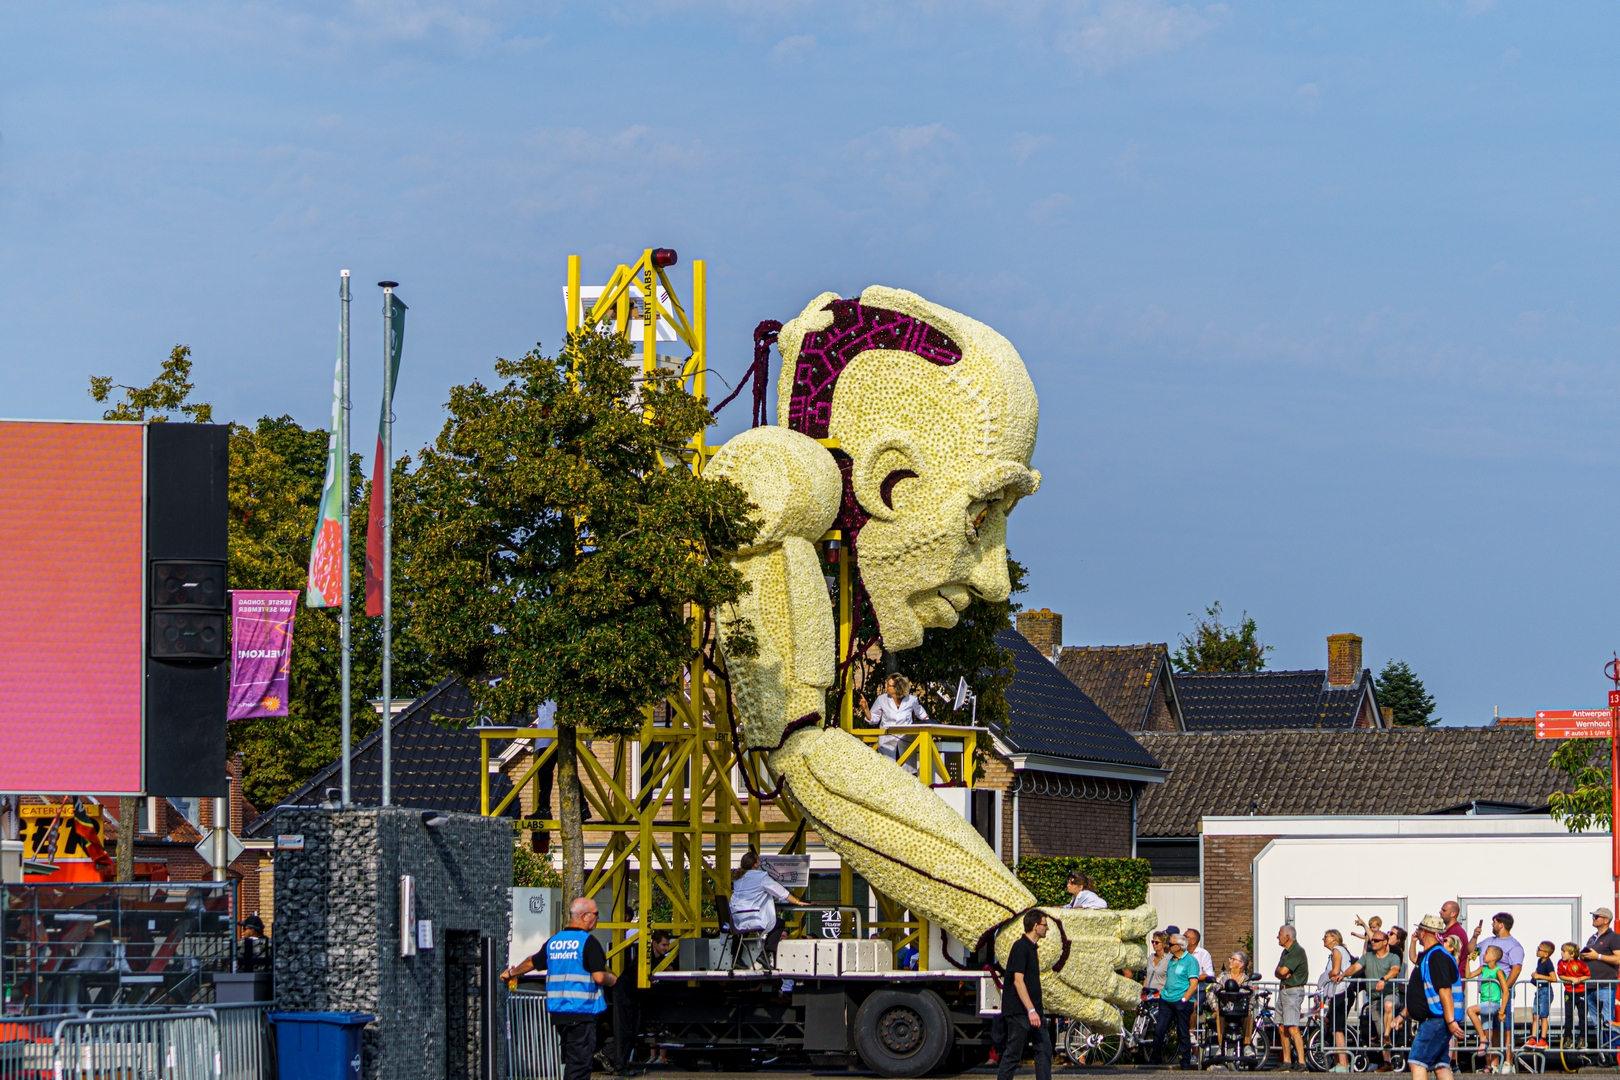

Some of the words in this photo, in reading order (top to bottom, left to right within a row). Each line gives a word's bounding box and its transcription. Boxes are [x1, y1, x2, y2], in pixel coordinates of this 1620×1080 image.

[644, 270, 652, 297] LABS
[644, 302, 652, 327] LENT
[1610, 694, 1619, 703] 13
[1572, 710, 1611, 718] Antwerpen
[521, 820, 544, 829] LABS
[549, 939, 580, 950] corso
[549, 950, 578, 960] zundert
